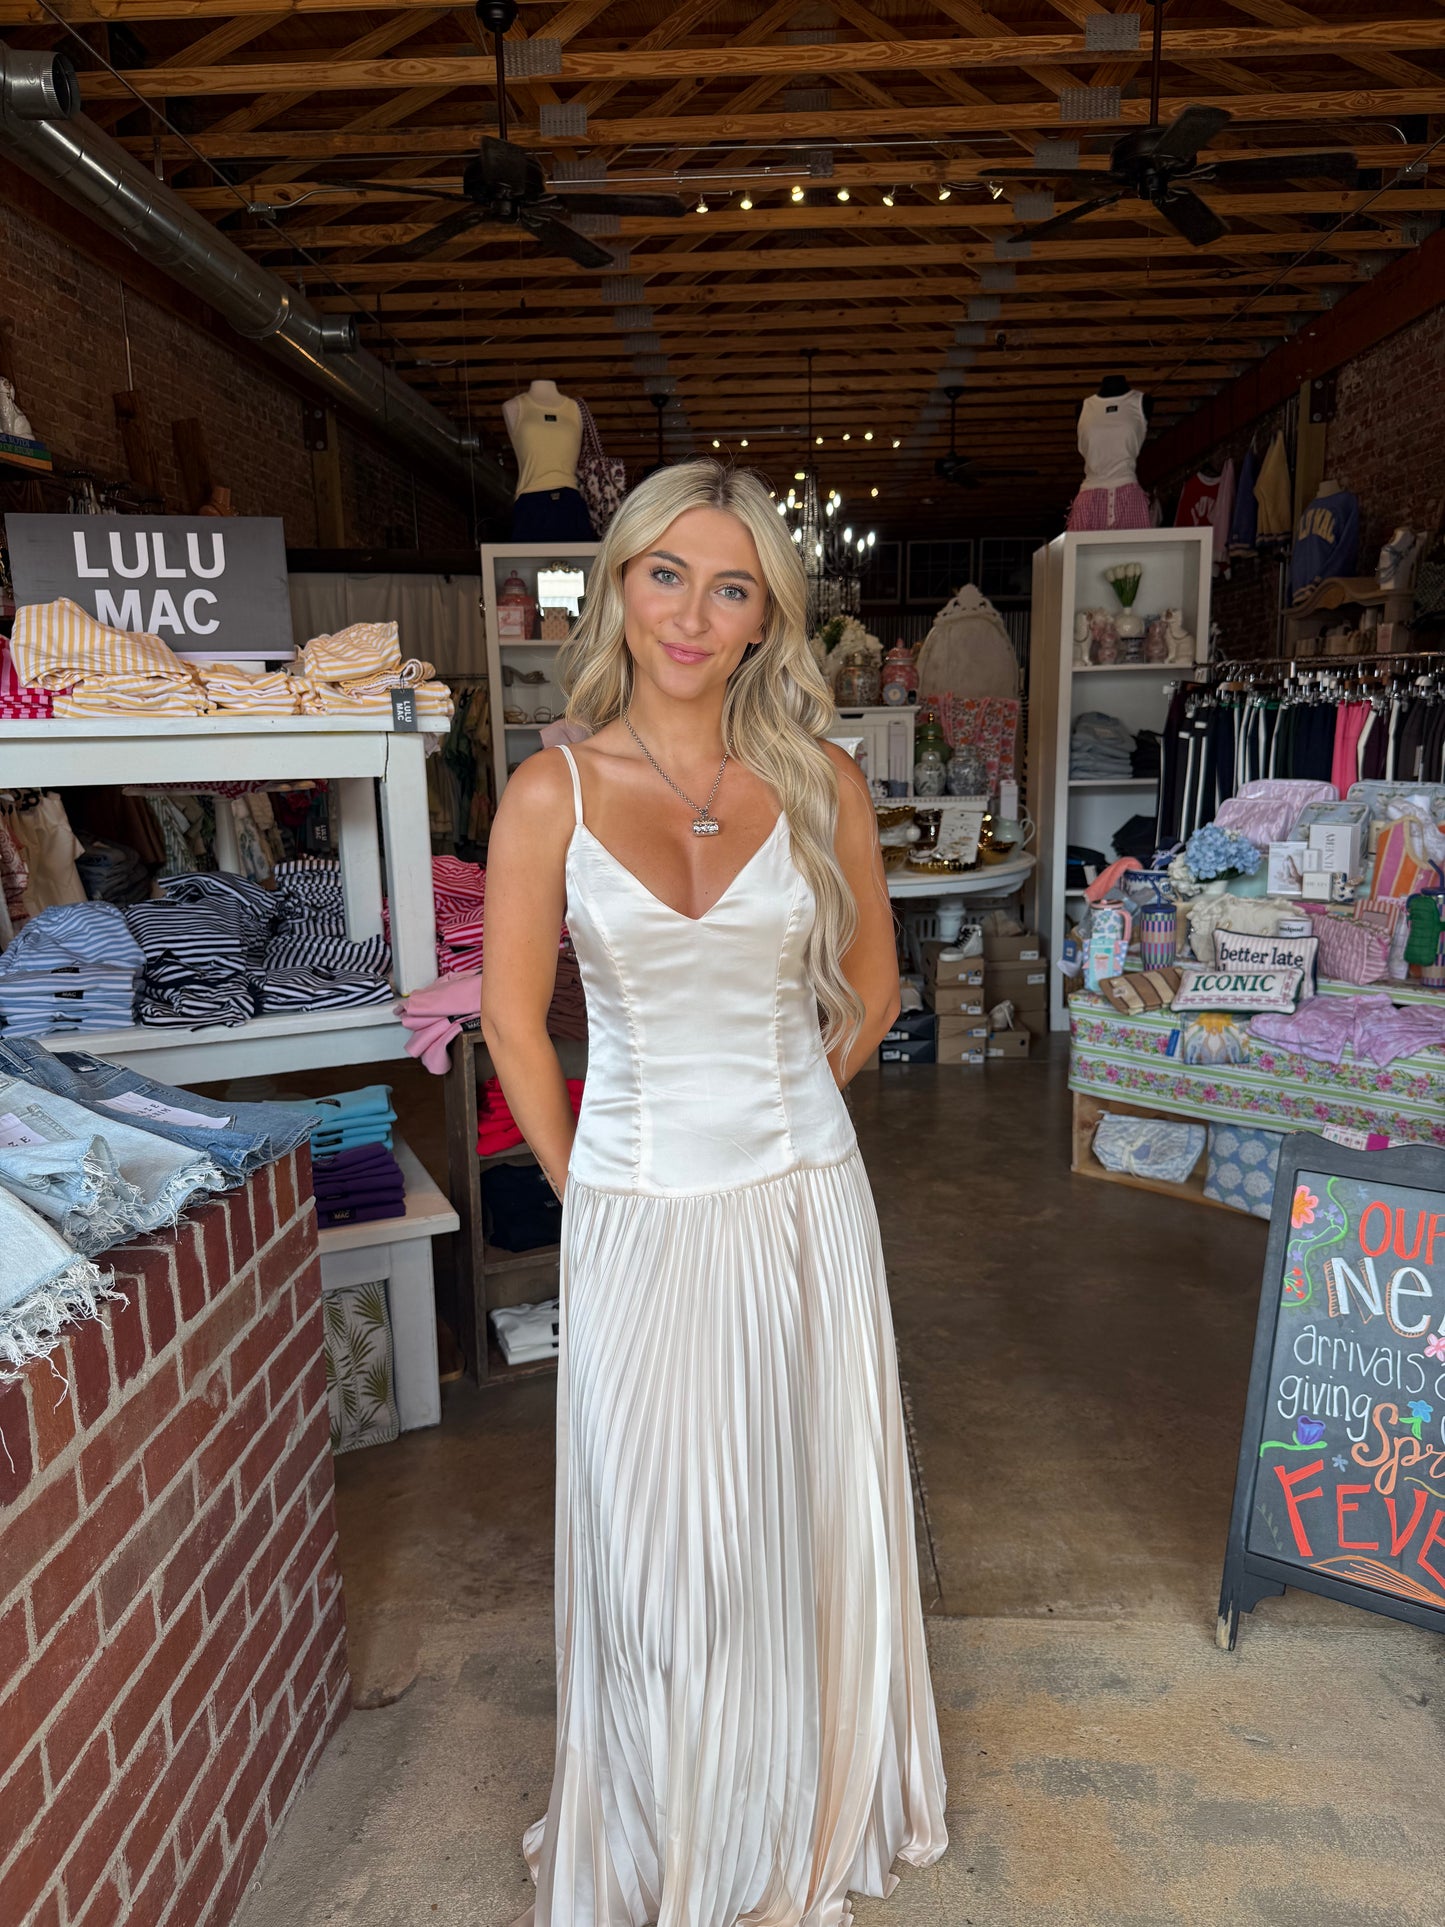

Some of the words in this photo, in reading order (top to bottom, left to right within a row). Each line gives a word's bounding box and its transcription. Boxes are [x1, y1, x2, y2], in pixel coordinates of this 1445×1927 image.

[73, 531, 226, 579] LULU
[94, 588, 220, 635] MAC
[396, 703, 404, 721] MAC
[403, 701, 412, 723] LULU
[1220, 943, 1268, 964] better
[1272, 947, 1304, 967] late
[1190, 974, 1276, 992] ICONIC
[1324, 1256, 1445, 1338] Ne
[1294, 1325, 1426, 1394] arrivals
[1277, 1375, 1372, 1441] giving
